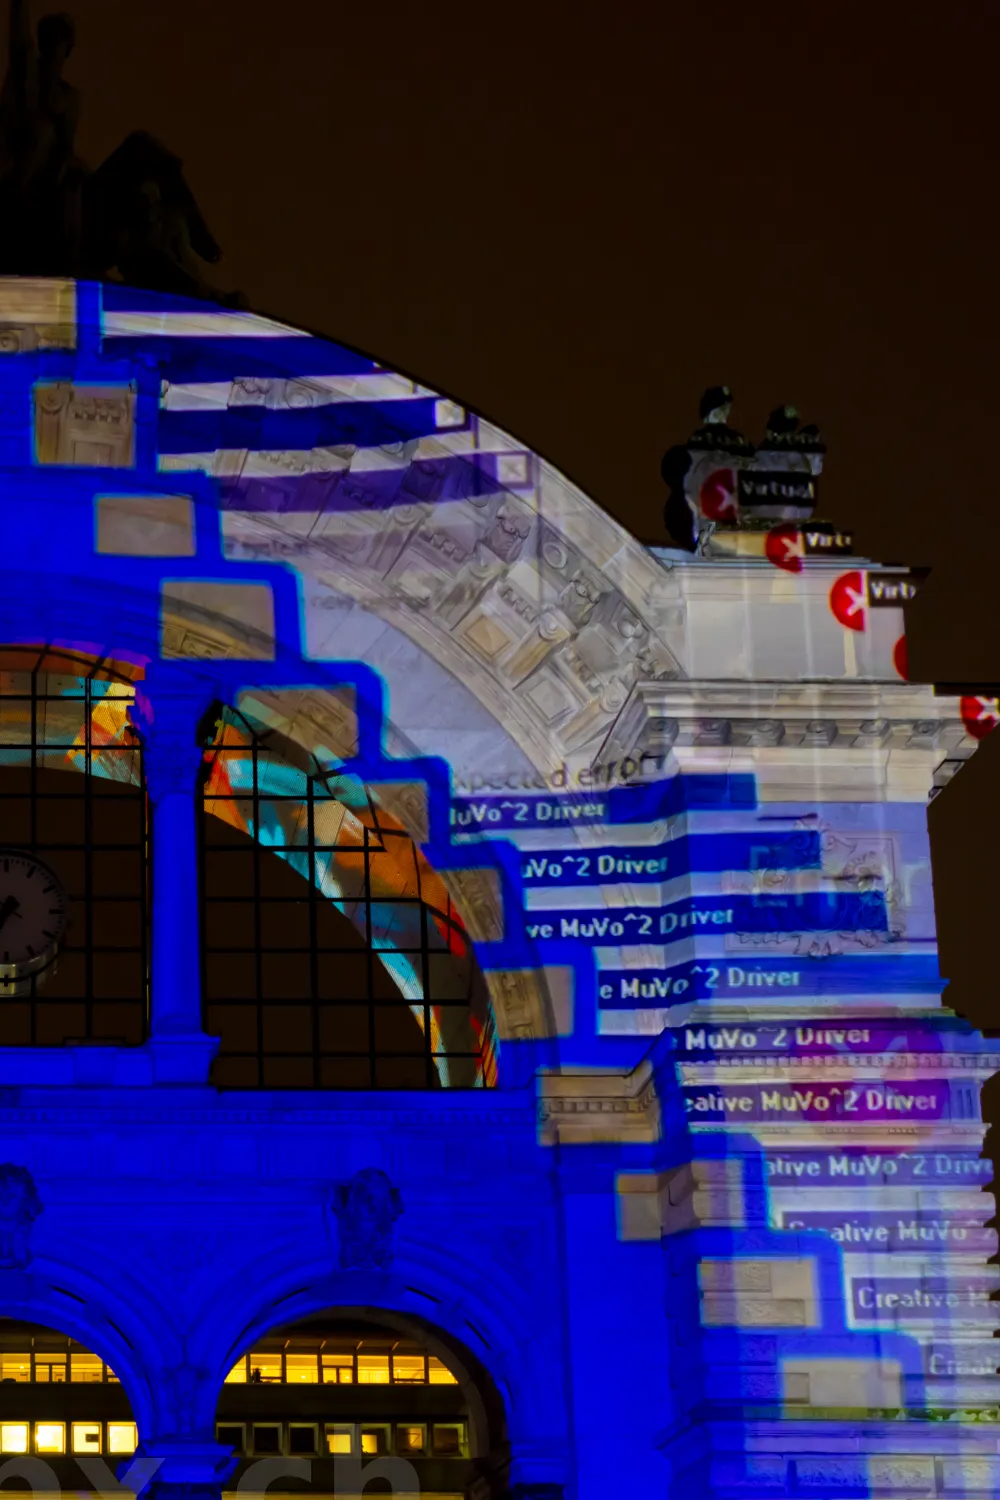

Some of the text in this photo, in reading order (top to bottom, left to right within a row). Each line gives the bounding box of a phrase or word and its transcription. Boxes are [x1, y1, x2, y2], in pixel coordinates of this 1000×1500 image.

[535, 802, 605, 821] Driver
[597, 854, 669, 876] Driver
[560, 912, 653, 938] MuVo^2
[659, 904, 734, 934] Driver
[620, 966, 720, 999] MuVo^2
[727, 966, 801, 987] Driver
[760, 1087, 859, 1113] MuVo^2
[866, 1089, 938, 1111] Driver
[857, 1286, 960, 1310] Creative
